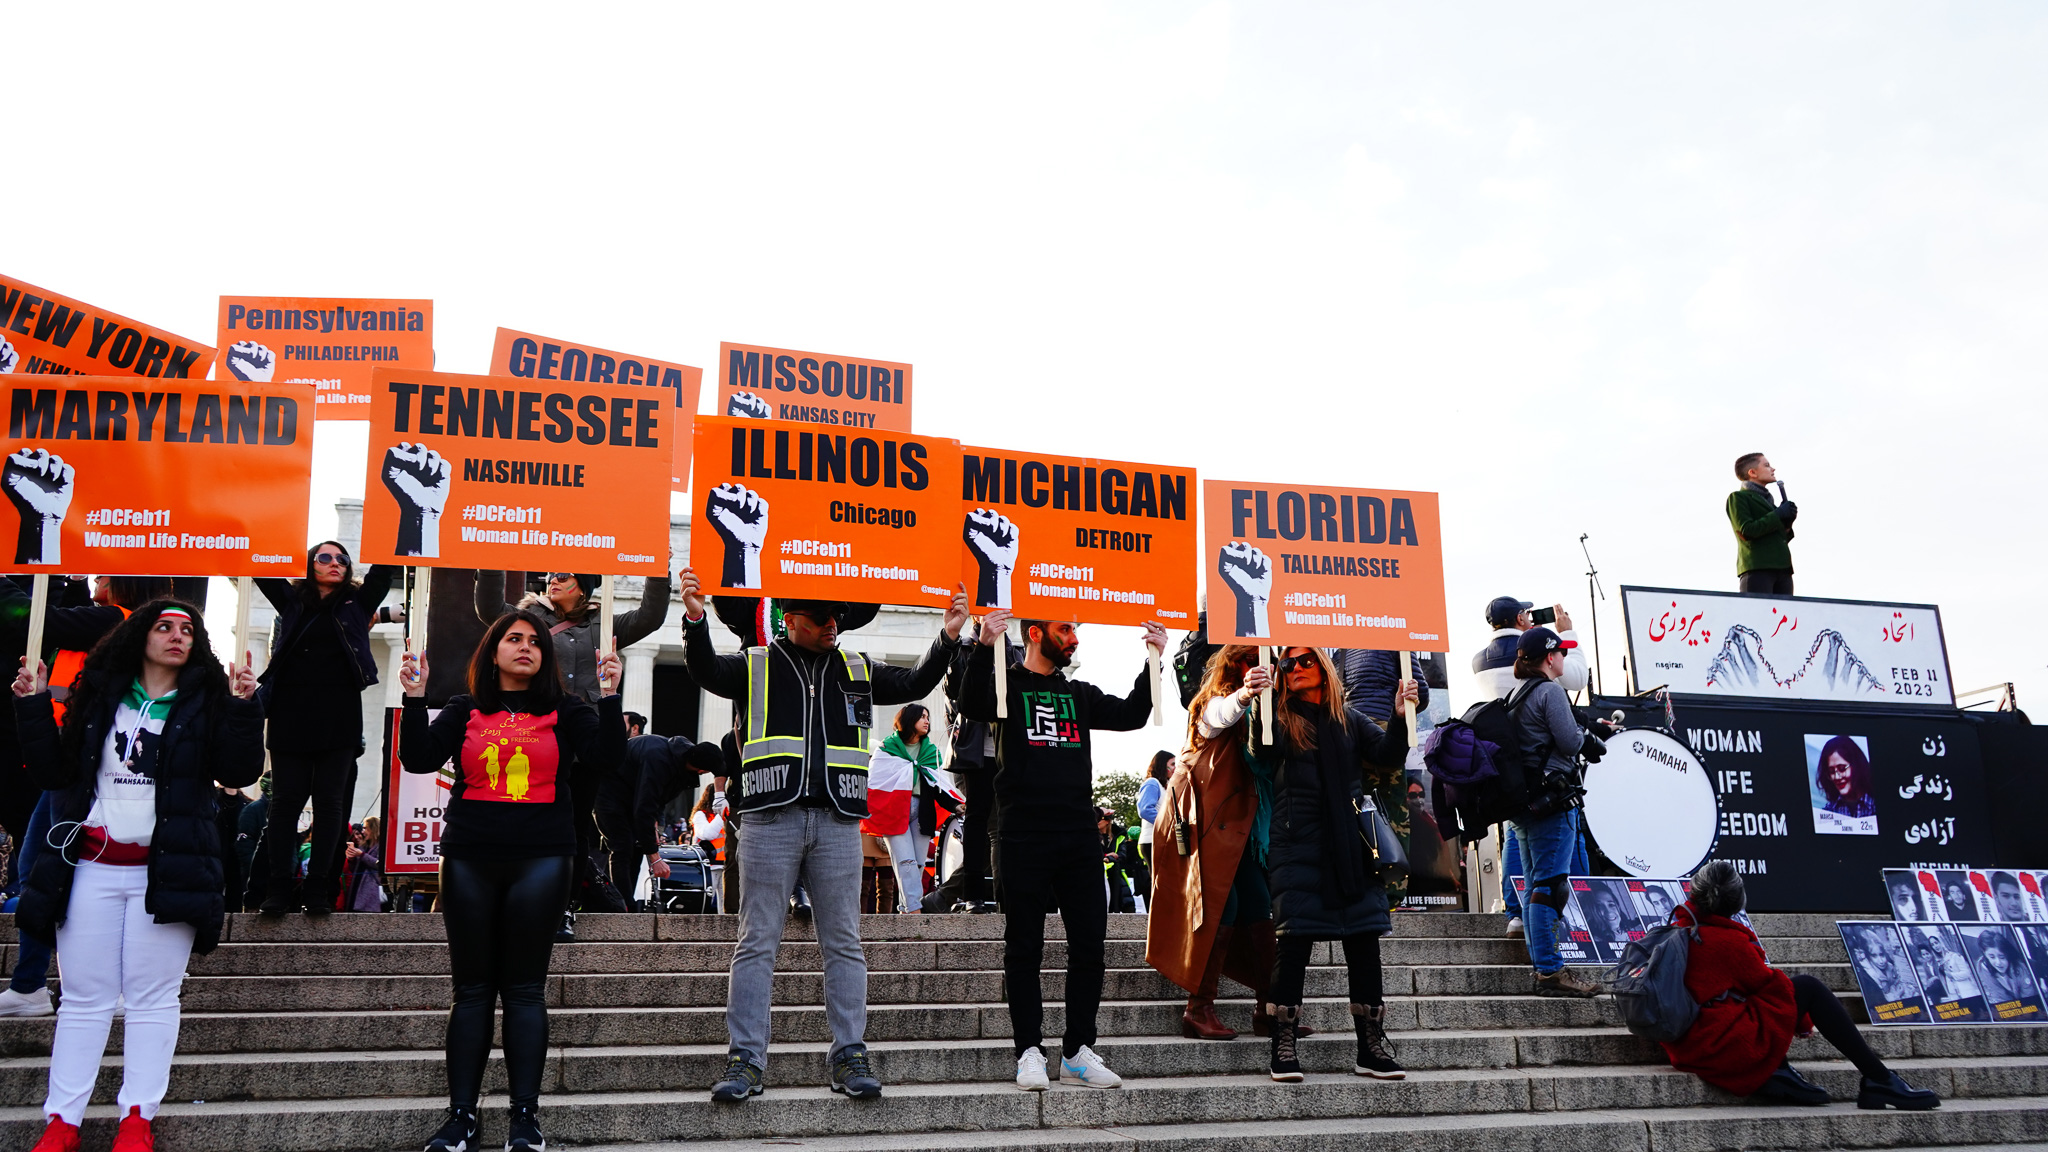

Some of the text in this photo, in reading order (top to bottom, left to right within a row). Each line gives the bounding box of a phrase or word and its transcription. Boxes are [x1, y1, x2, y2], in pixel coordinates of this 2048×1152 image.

[227, 304, 424, 334] Pennsylvania
[0, 284, 201, 379] NEW YORK
[284, 345, 399, 361] PHILADELPHIA
[729, 350, 904, 404] MISSOURI
[327, 394, 346, 403] Life
[348, 394, 371, 403] Free
[9, 388, 298, 446] MARYLAND
[389, 382, 659, 448] TENNESSEE
[780, 404, 876, 428] KANSAS CITY
[731, 427, 929, 491] ILLINOIS
[463, 458, 585, 487] NASHVILLE
[961, 454, 1187, 521] MICHIGAN
[86, 509, 170, 526] #DCFeb11
[462, 504, 542, 524] #DCFeb11
[830, 500, 917, 529] Chicago
[1231, 489, 1418, 547] FLORIDA
[84, 531, 250, 550] Woman Life Freedom
[461, 526, 615, 549] Woman Life Freedom
[1075, 527, 1152, 554] DETROIT
[251, 553, 293, 563] @nsgiran
[617, 552, 655, 563] @nsgiran
[780, 539, 852, 558] #DCFeb11
[780, 560, 919, 581] Woman Life Freedom
[1029, 563, 1093, 582] #DCFeb11
[1281, 553, 1400, 578] TALLAHASSEE
[921, 585, 951, 597] @nsgiran
[1029, 582, 1155, 605] Woman Life Freedom
[1284, 592, 1346, 609] #DCFeb11
[1156, 609, 1187, 619] @nsgiran
[1284, 611, 1407, 629] Woman Life Freedom
[1649, 601, 1914, 646] اتحاد رمز پیروزی
[1409, 632, 1439, 641] @nsgiran
[1891, 667, 1938, 681] FEB 11
[1894, 683, 1933, 697] 2023
[1687, 728, 1763, 753] WOMAN
[1922, 735, 1946, 756] زن
[1646, 745, 1687, 774] YAMAHA
[742, 764, 790, 798] SECURITY
[839, 773, 868, 801] SECUR
[1718, 770, 1753, 794] IFE
[1899, 775, 1953, 801] زندگی
[414, 807, 447, 818] HO
[1719, 812, 1788, 837] EEDOM
[1905, 816, 1955, 845] آزادی
[407, 844, 425, 855] IS
[1708, 859, 1767, 874] IRAN
[1628, 881, 1643, 889] SOS
[1408, 896, 1423, 904] LIFE
[1424, 896, 1457, 904] FREEDOM
[1559, 943, 1579, 951] EHRAD
[1570, 931, 1592, 942] FREE
